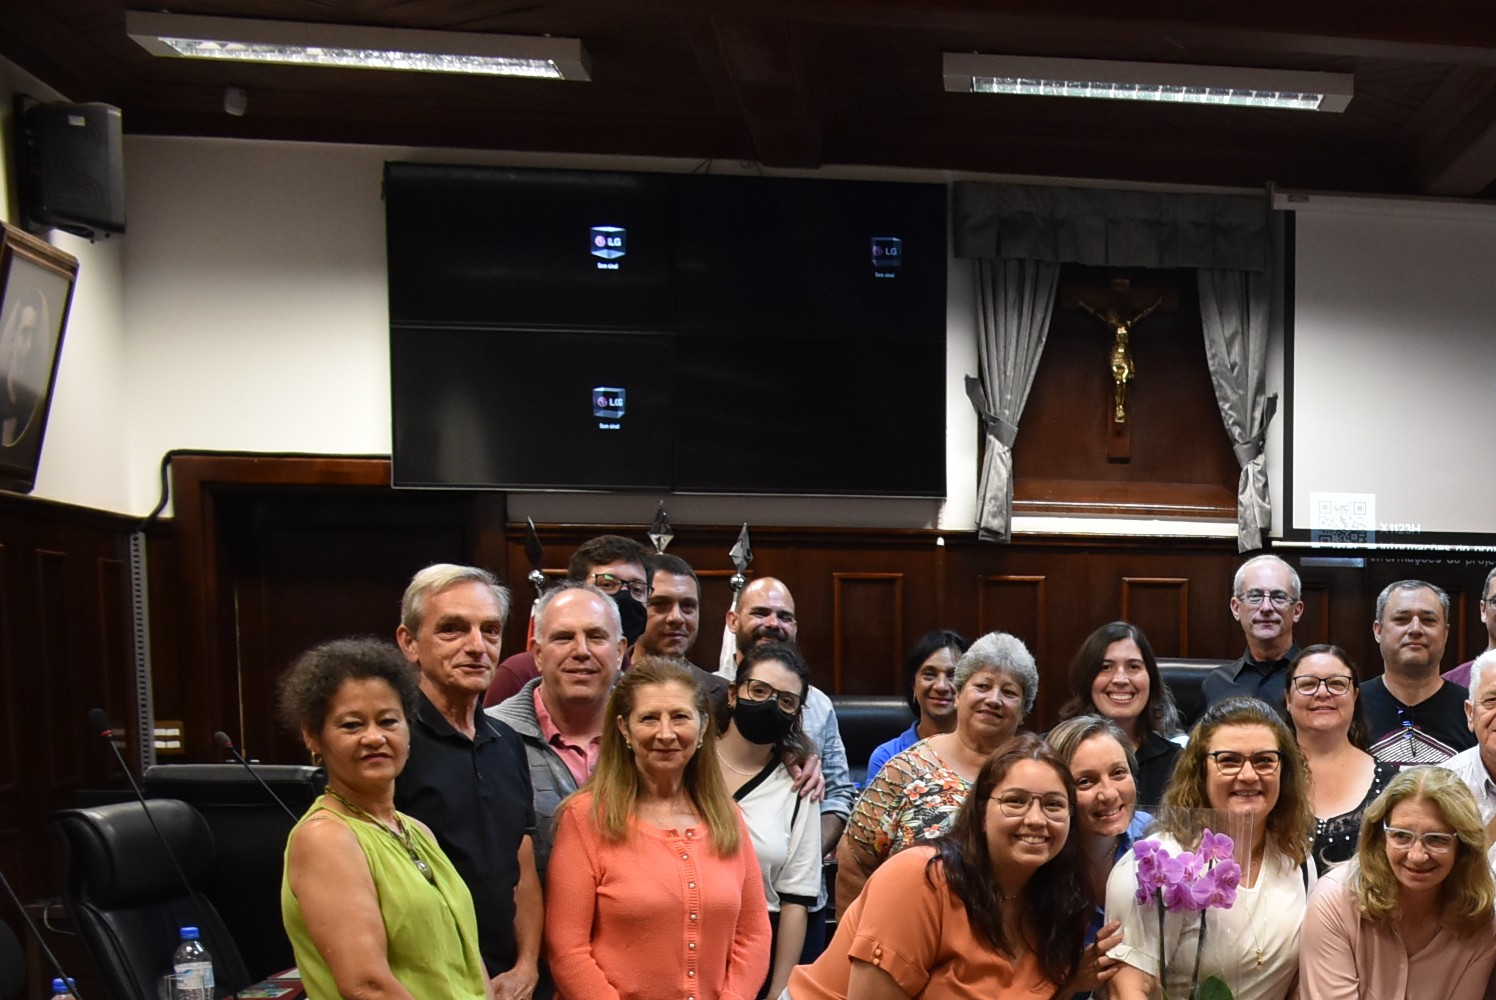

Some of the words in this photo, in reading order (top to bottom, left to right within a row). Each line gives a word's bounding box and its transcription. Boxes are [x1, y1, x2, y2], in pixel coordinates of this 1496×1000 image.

[607, 237, 622, 247] LG
[885, 247, 898, 256] LG
[609, 398, 624, 407] LG
[1380, 522, 1420, 535] X1123H
